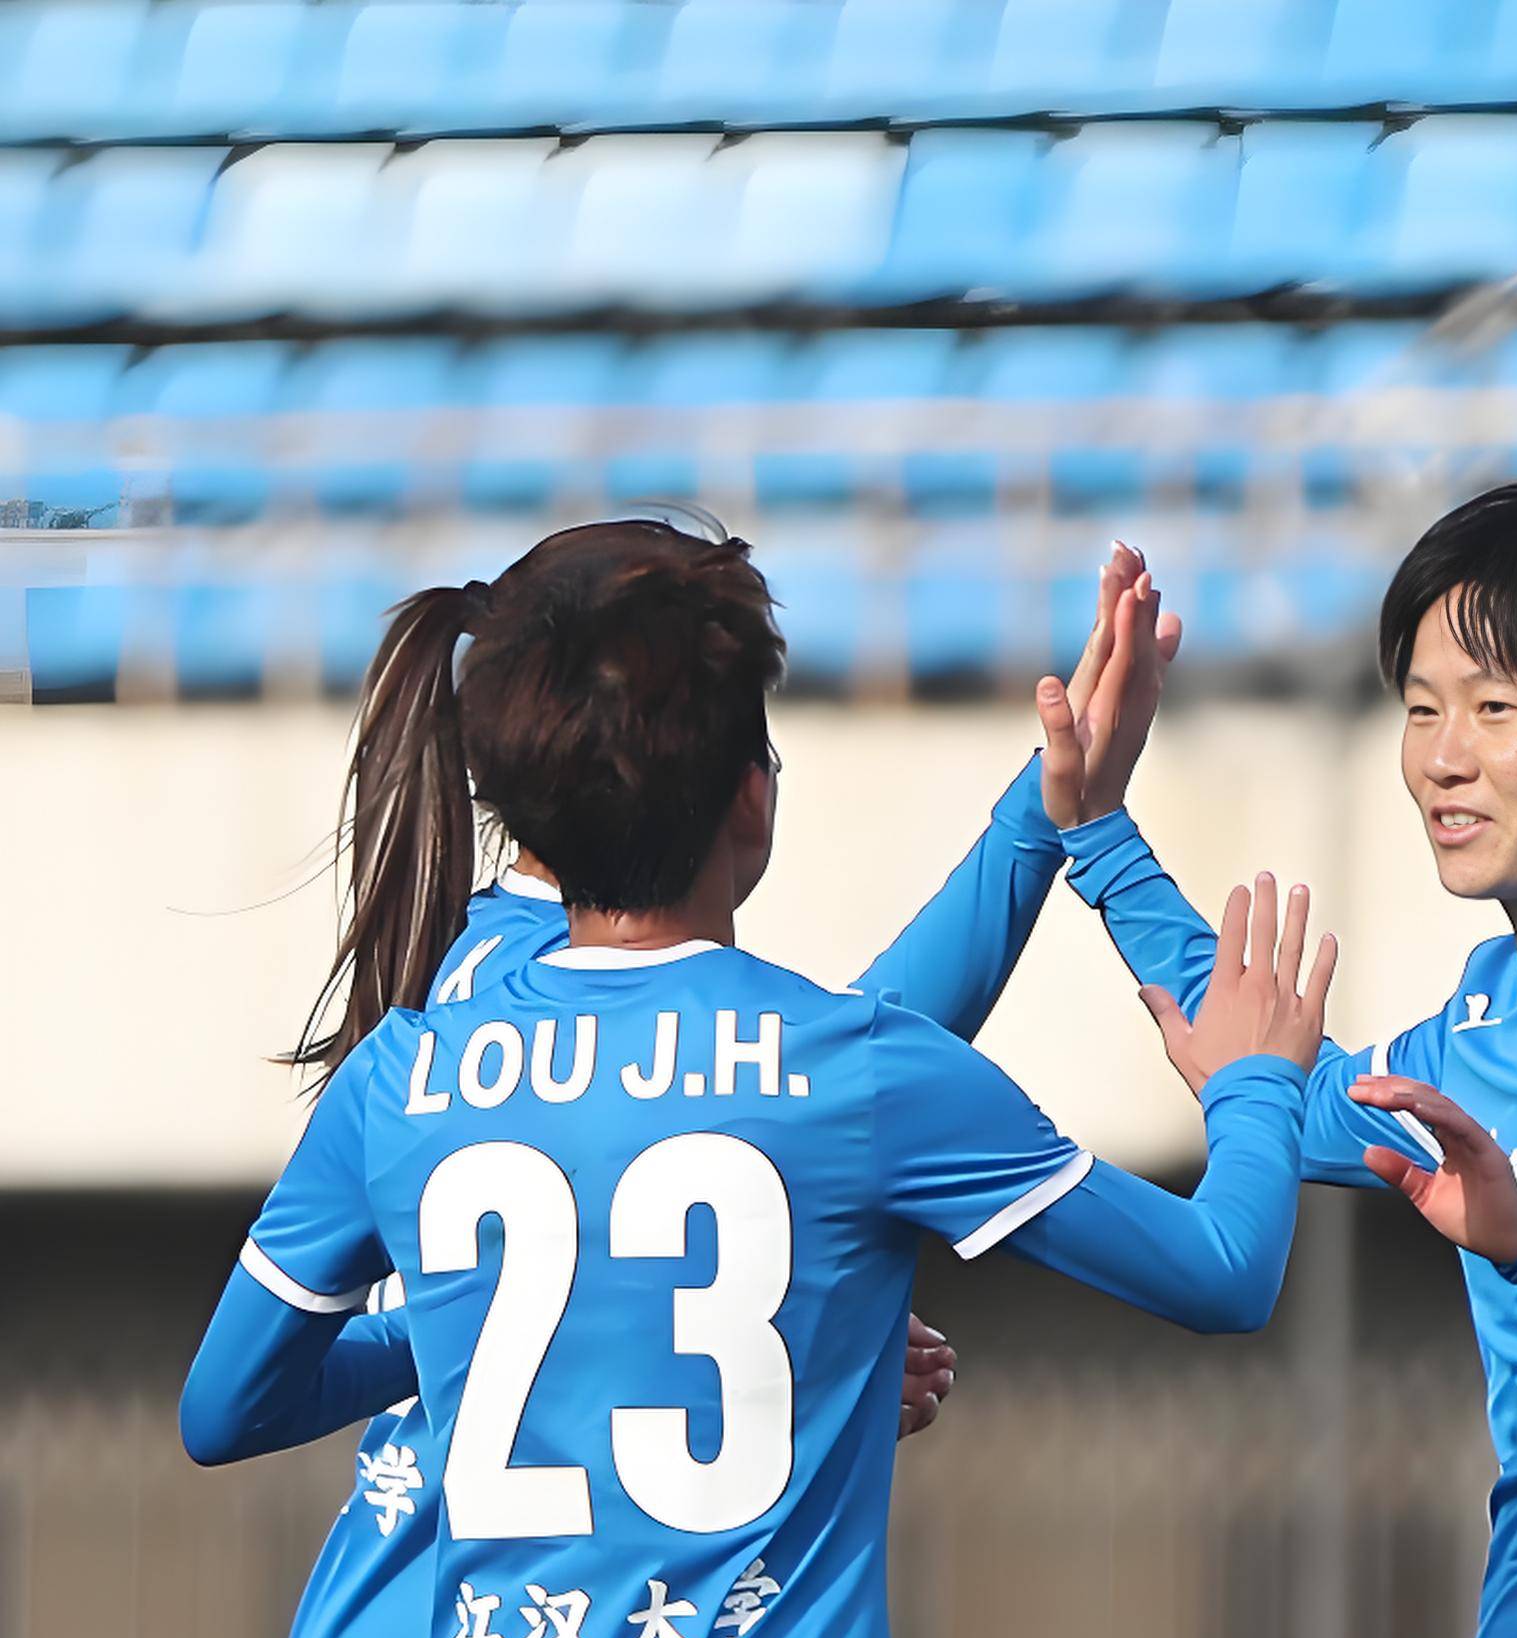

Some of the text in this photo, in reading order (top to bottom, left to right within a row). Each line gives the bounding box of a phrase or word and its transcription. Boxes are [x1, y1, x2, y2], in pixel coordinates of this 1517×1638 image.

[404, 1009, 811, 1115] LOU J.H.
[418, 1131, 794, 1541] 23
